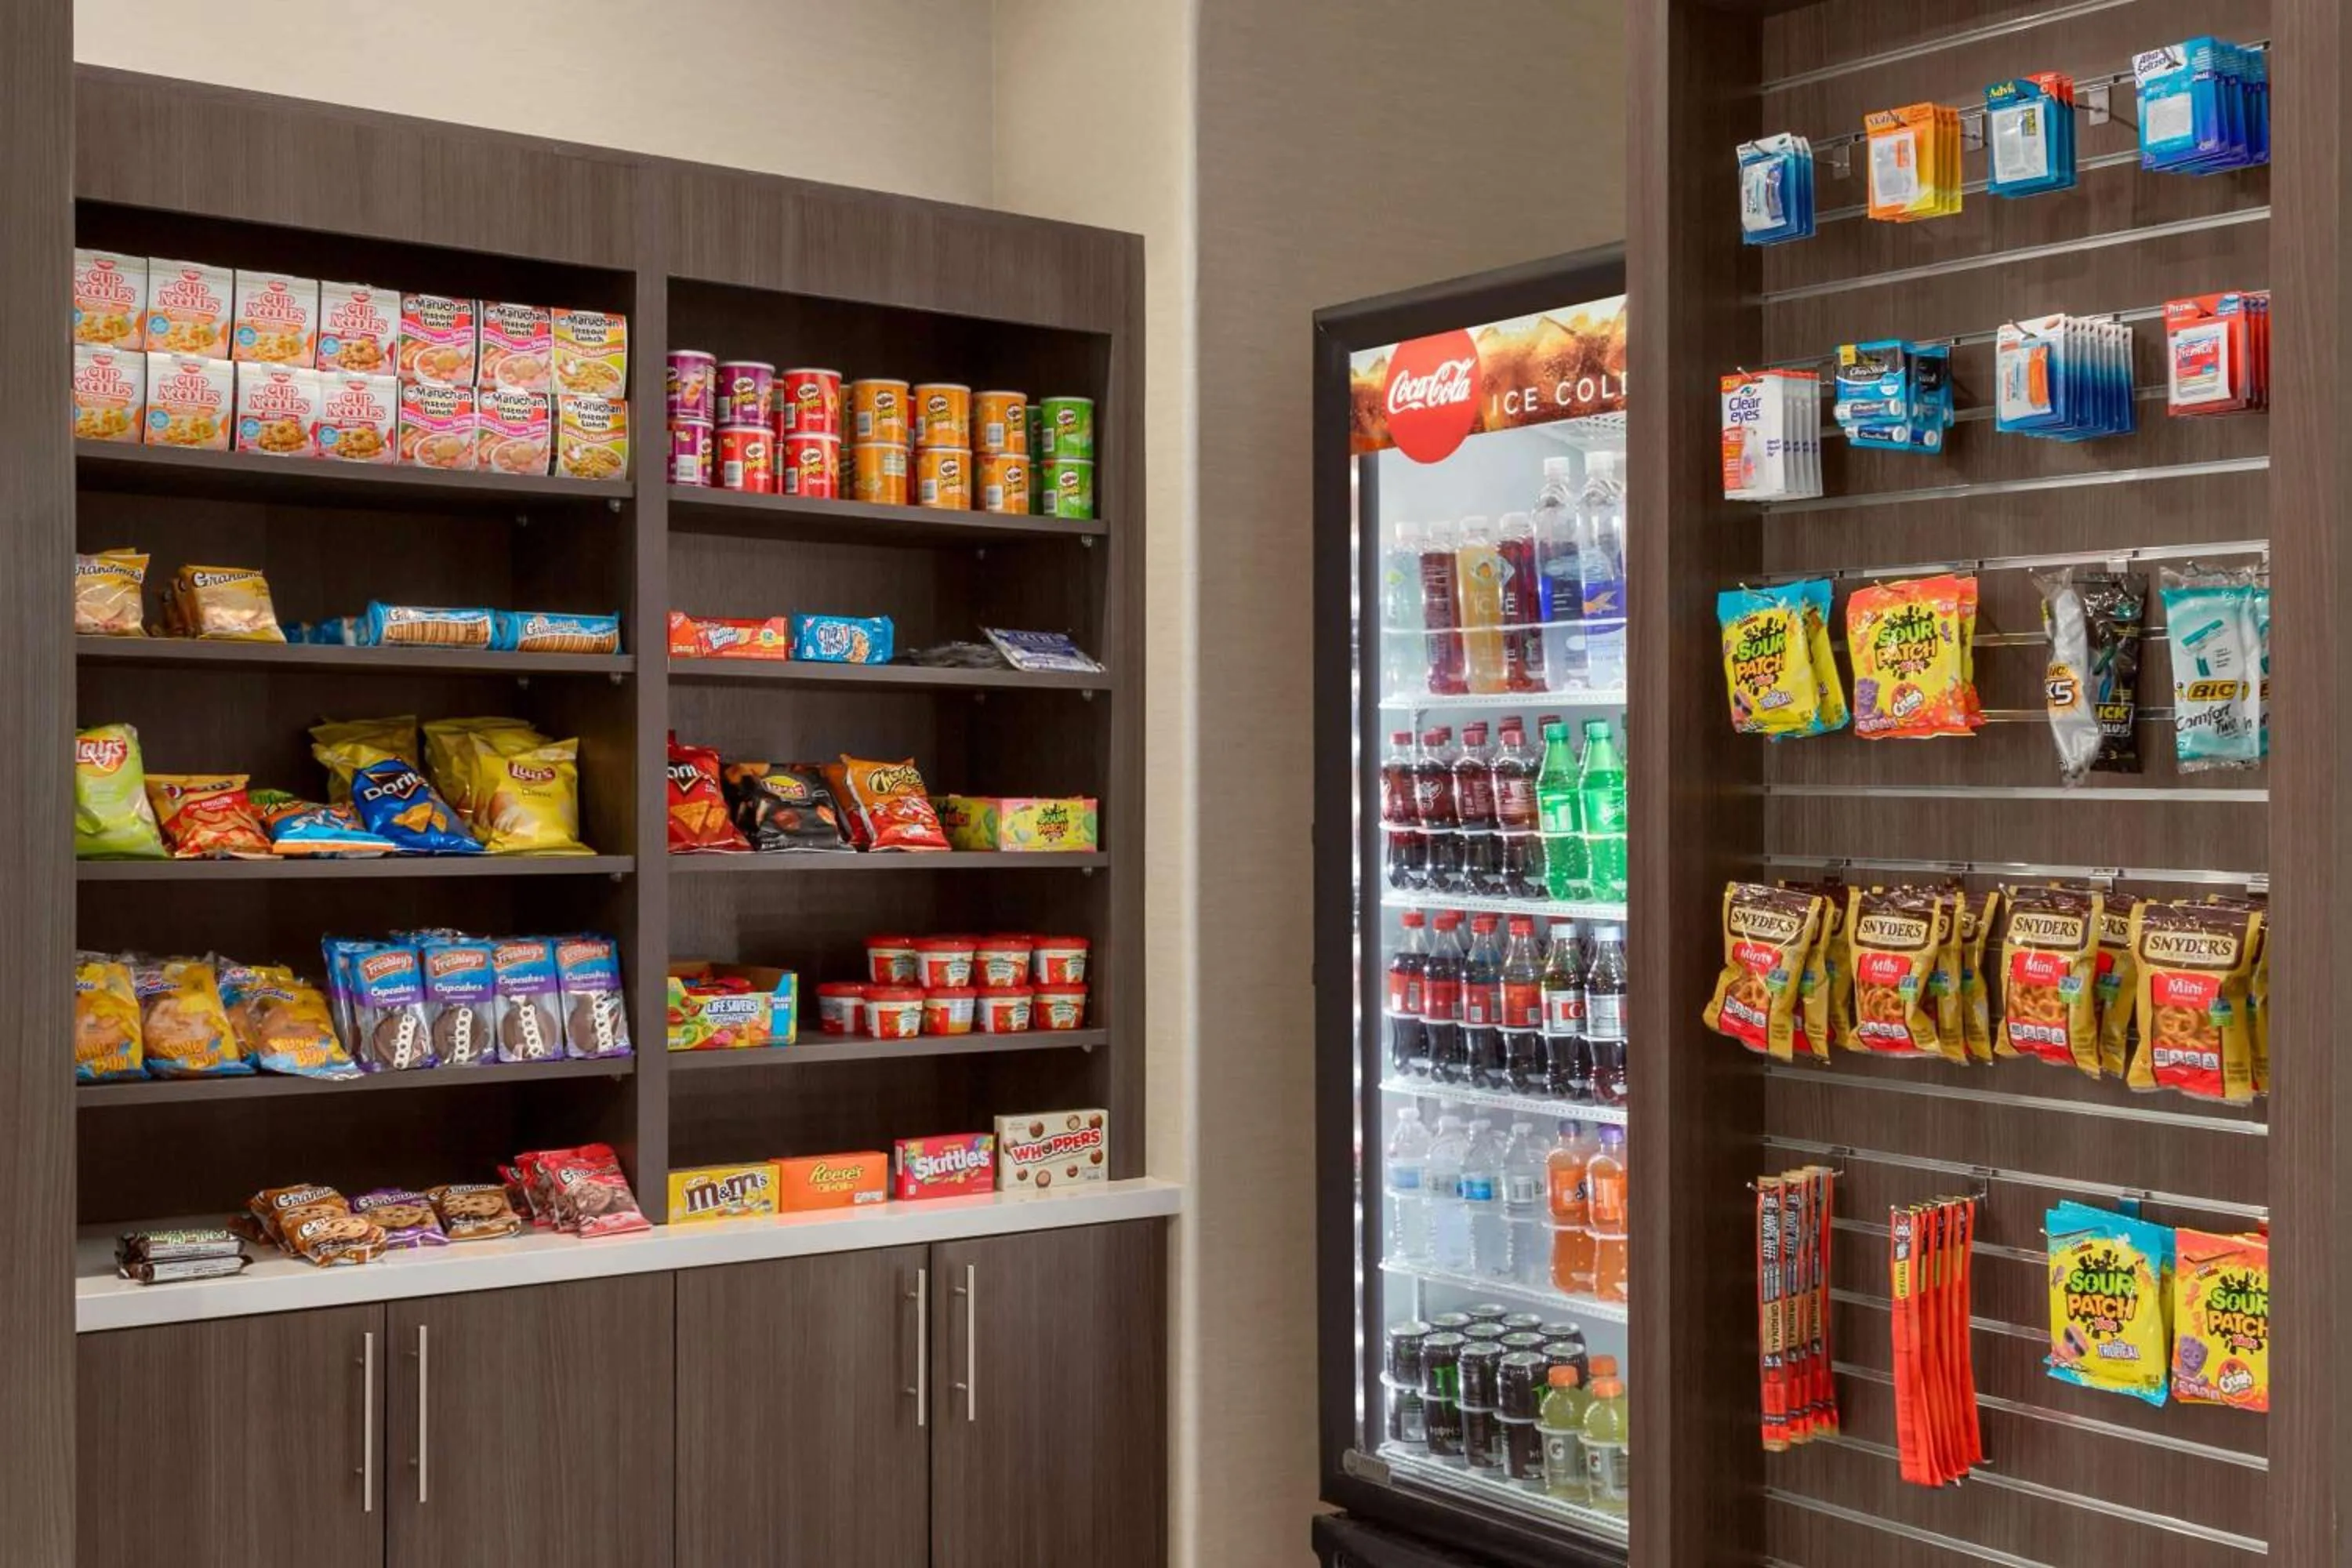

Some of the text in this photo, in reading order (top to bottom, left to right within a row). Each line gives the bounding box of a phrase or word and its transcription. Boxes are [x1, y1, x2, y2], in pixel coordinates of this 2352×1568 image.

[88, 272, 123, 285] CUP
[175, 281, 209, 297] CUP
[260, 292, 295, 307] CUP
[416, 299, 471, 313] Maruchan
[344, 303, 377, 317] CUP
[497, 309, 548, 321] Maruchan
[567, 314, 618, 327] Maruchan
[85, 366, 122, 379] CUP
[175, 375, 209, 389] CUP
[263, 385, 298, 399] CUP
[340, 393, 374, 407] CUP
[416, 386, 471, 400] Maruchan
[494, 392, 546, 406] Maruchan
[574, 401, 622, 413] Maruchan
[1492, 387, 1538, 416] ICE
[1729, 397, 1762, 412] Clear
[1730, 408, 1760, 426] eyes
[1878, 620, 1934, 646] SOUR
[1737, 632, 1786, 661] SOUR
[1876, 640, 1937, 667] PATCH
[1734, 653, 1784, 677] PATCH
[2191, 682, 2236, 699] BIC
[1862, 920, 1922, 938] SNYDER'S
[2014, 916, 2078, 938] SNYDER'S
[2024, 960, 2054, 975] Mini
[1013, 1129, 1101, 1162] WHOPPERS
[913, 1149, 990, 1180] Skittles
[808, 1162, 864, 1185] Reese's
[2069, 1269, 2134, 1296] SOUR
[2067, 1294, 2137, 1322] PATCH
[1770, 1304, 1780, 1348] ORIGINAL
